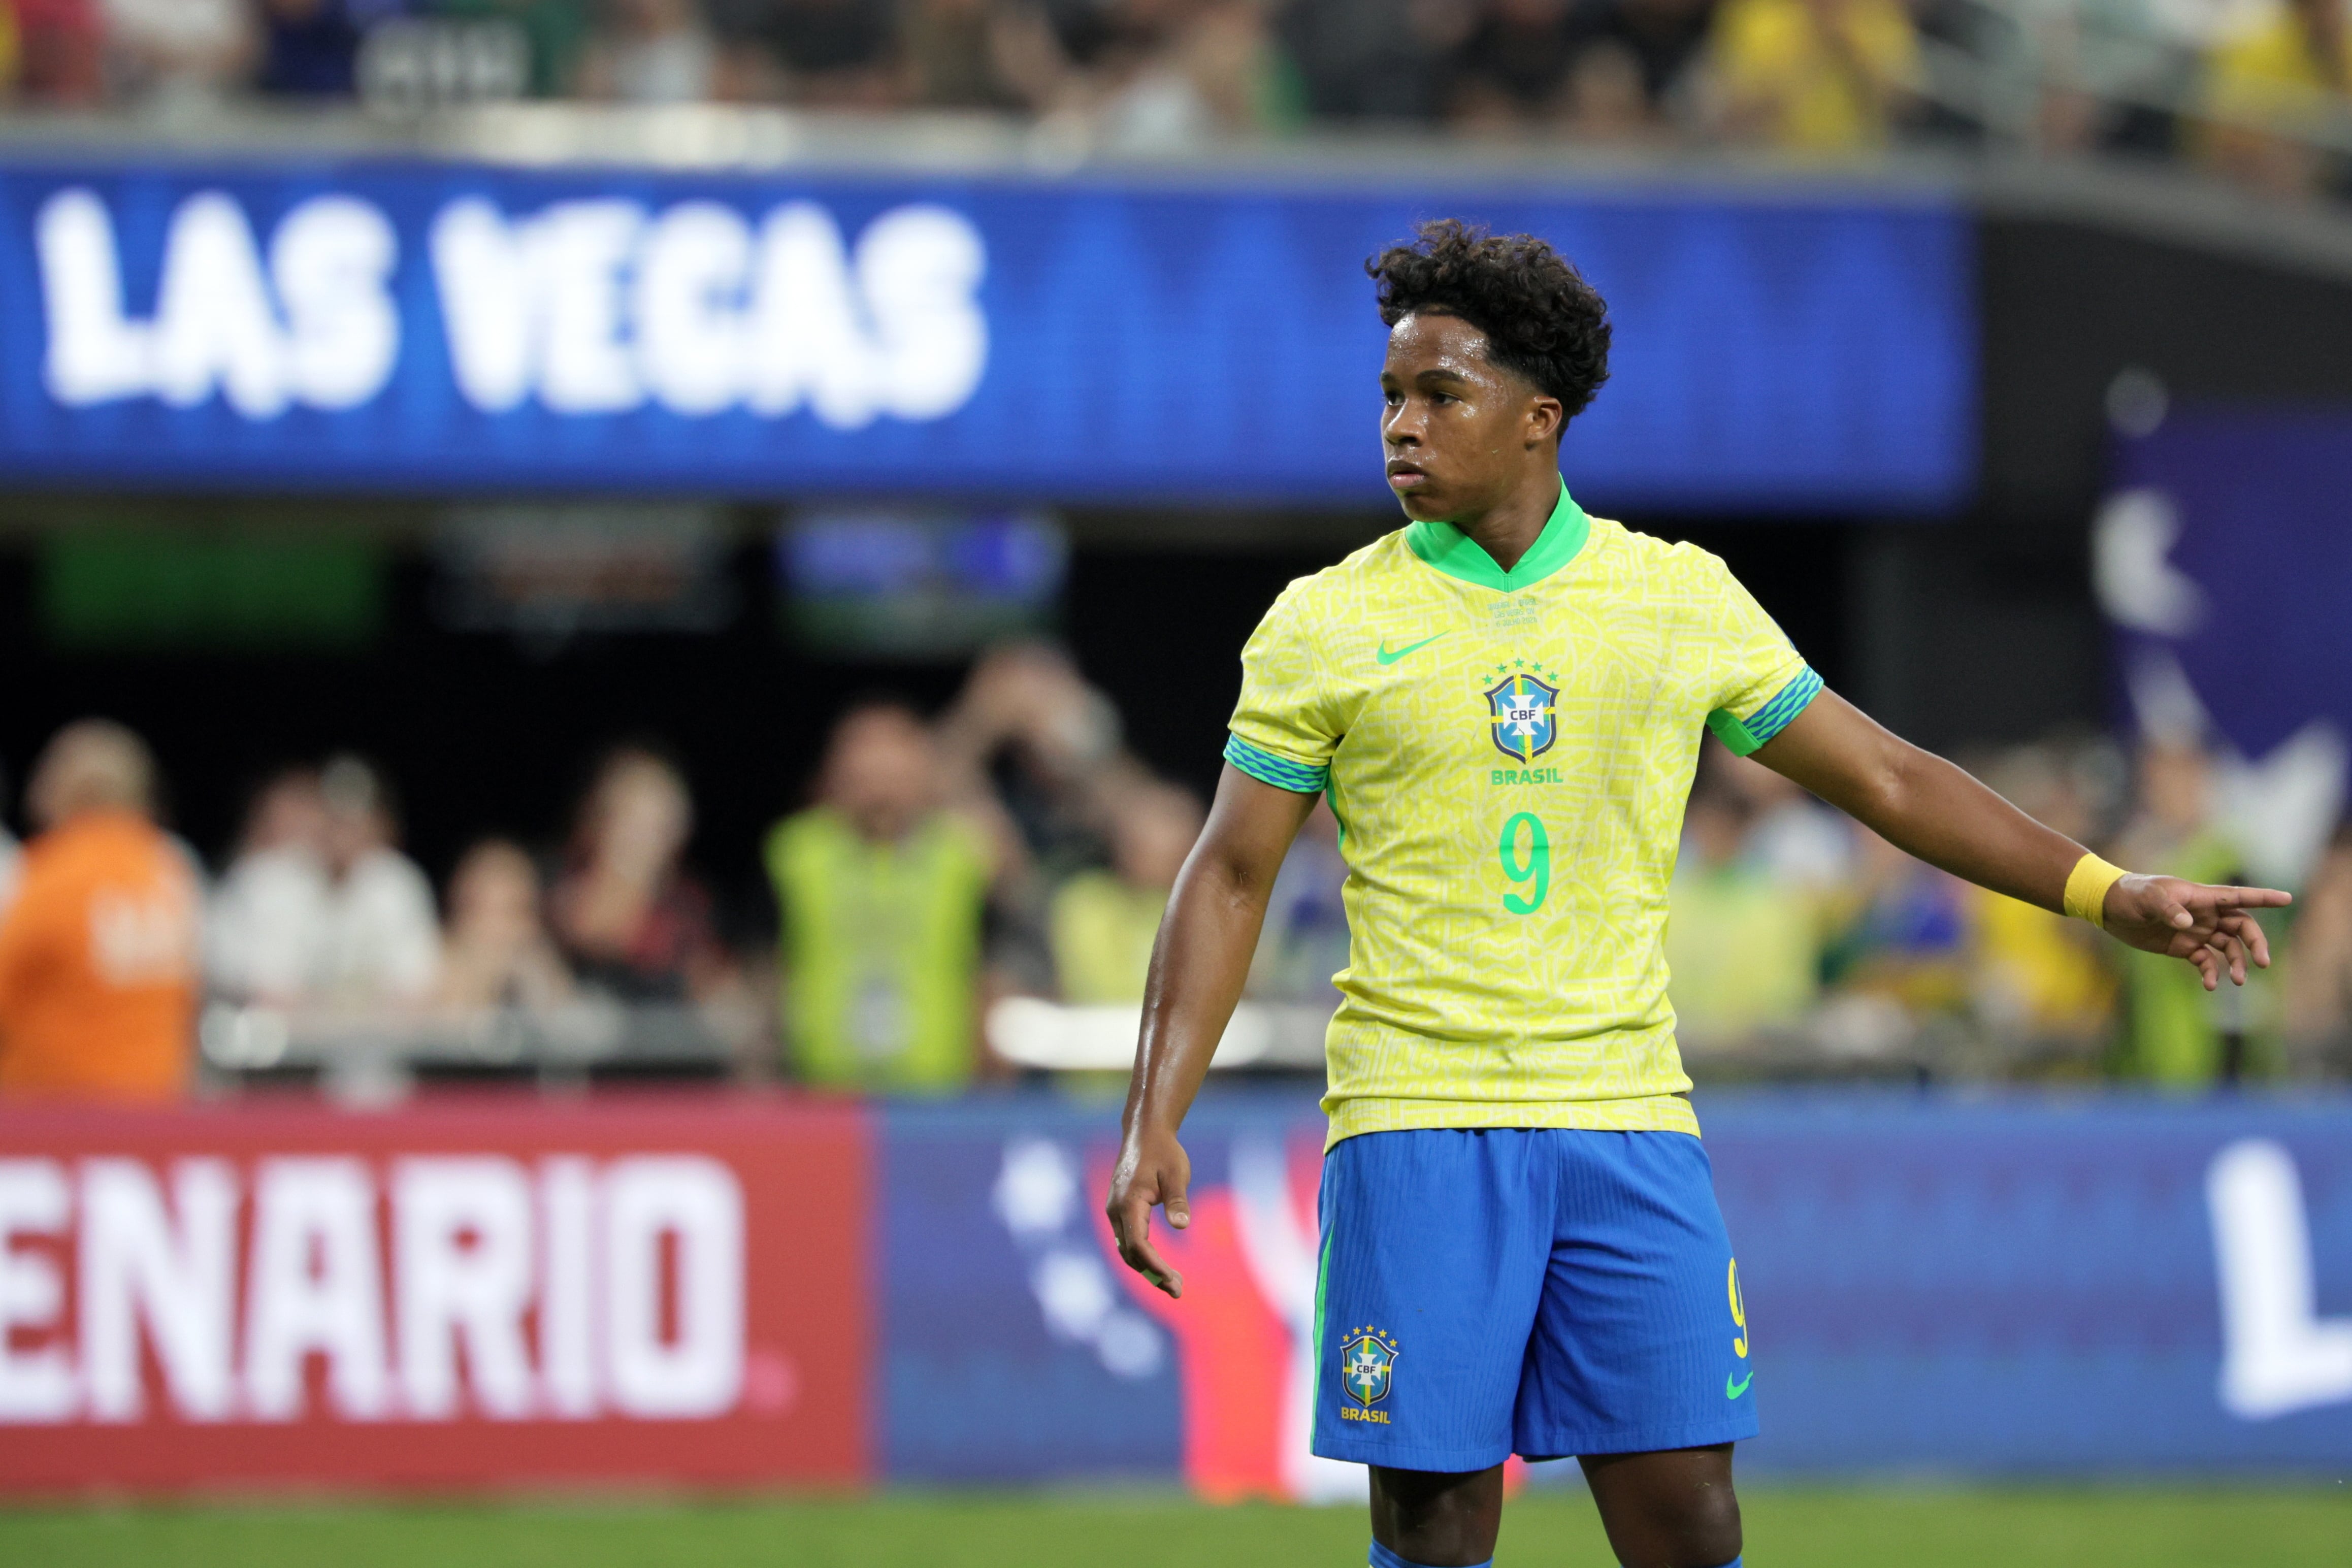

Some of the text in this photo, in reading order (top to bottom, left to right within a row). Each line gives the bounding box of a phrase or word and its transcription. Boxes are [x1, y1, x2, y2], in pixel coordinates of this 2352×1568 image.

[35, 187, 990, 429] LAS VEGAS
[1510, 709, 1536, 720] CBF
[1491, 768, 1563, 786] BRASIL
[1499, 811, 1550, 914] 9
[1728, 1257, 1748, 1359] 9
[1357, 1365, 1376, 1374] CBF
[1341, 1407, 1391, 1424] BRASIL
